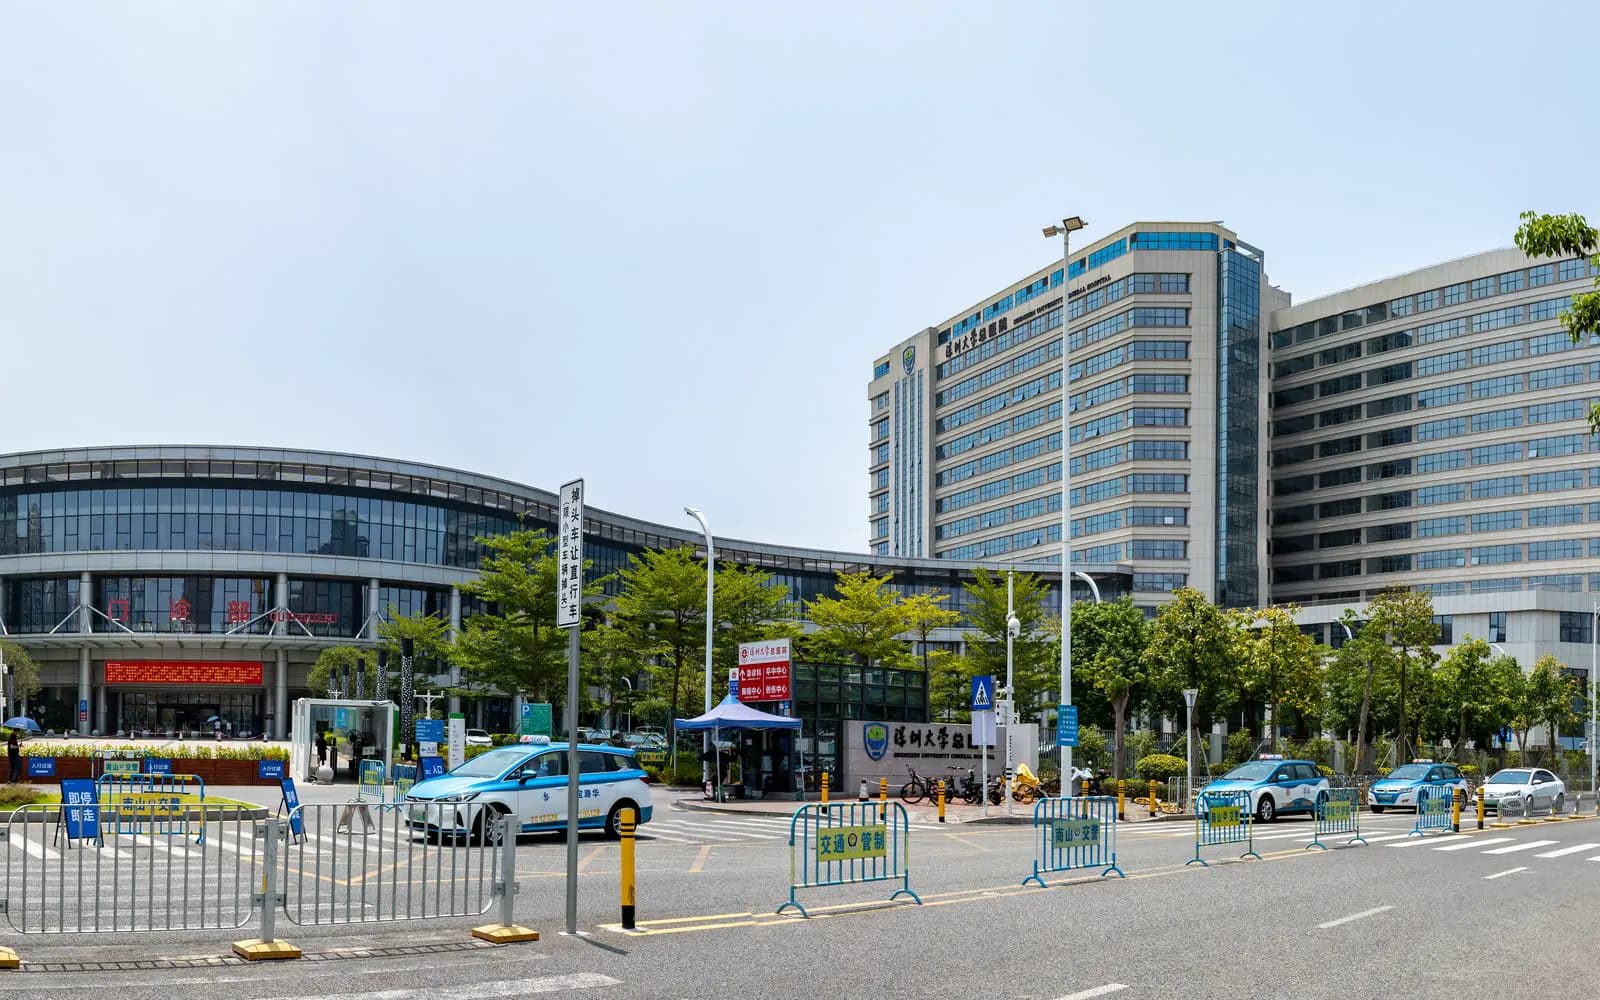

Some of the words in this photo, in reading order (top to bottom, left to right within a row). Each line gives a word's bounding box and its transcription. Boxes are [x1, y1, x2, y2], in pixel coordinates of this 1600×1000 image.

[568, 487, 580, 618] 掉头车让直行车
[894, 726, 995, 750] 深圳大学总
[820, 831, 885, 855] 交通管制
